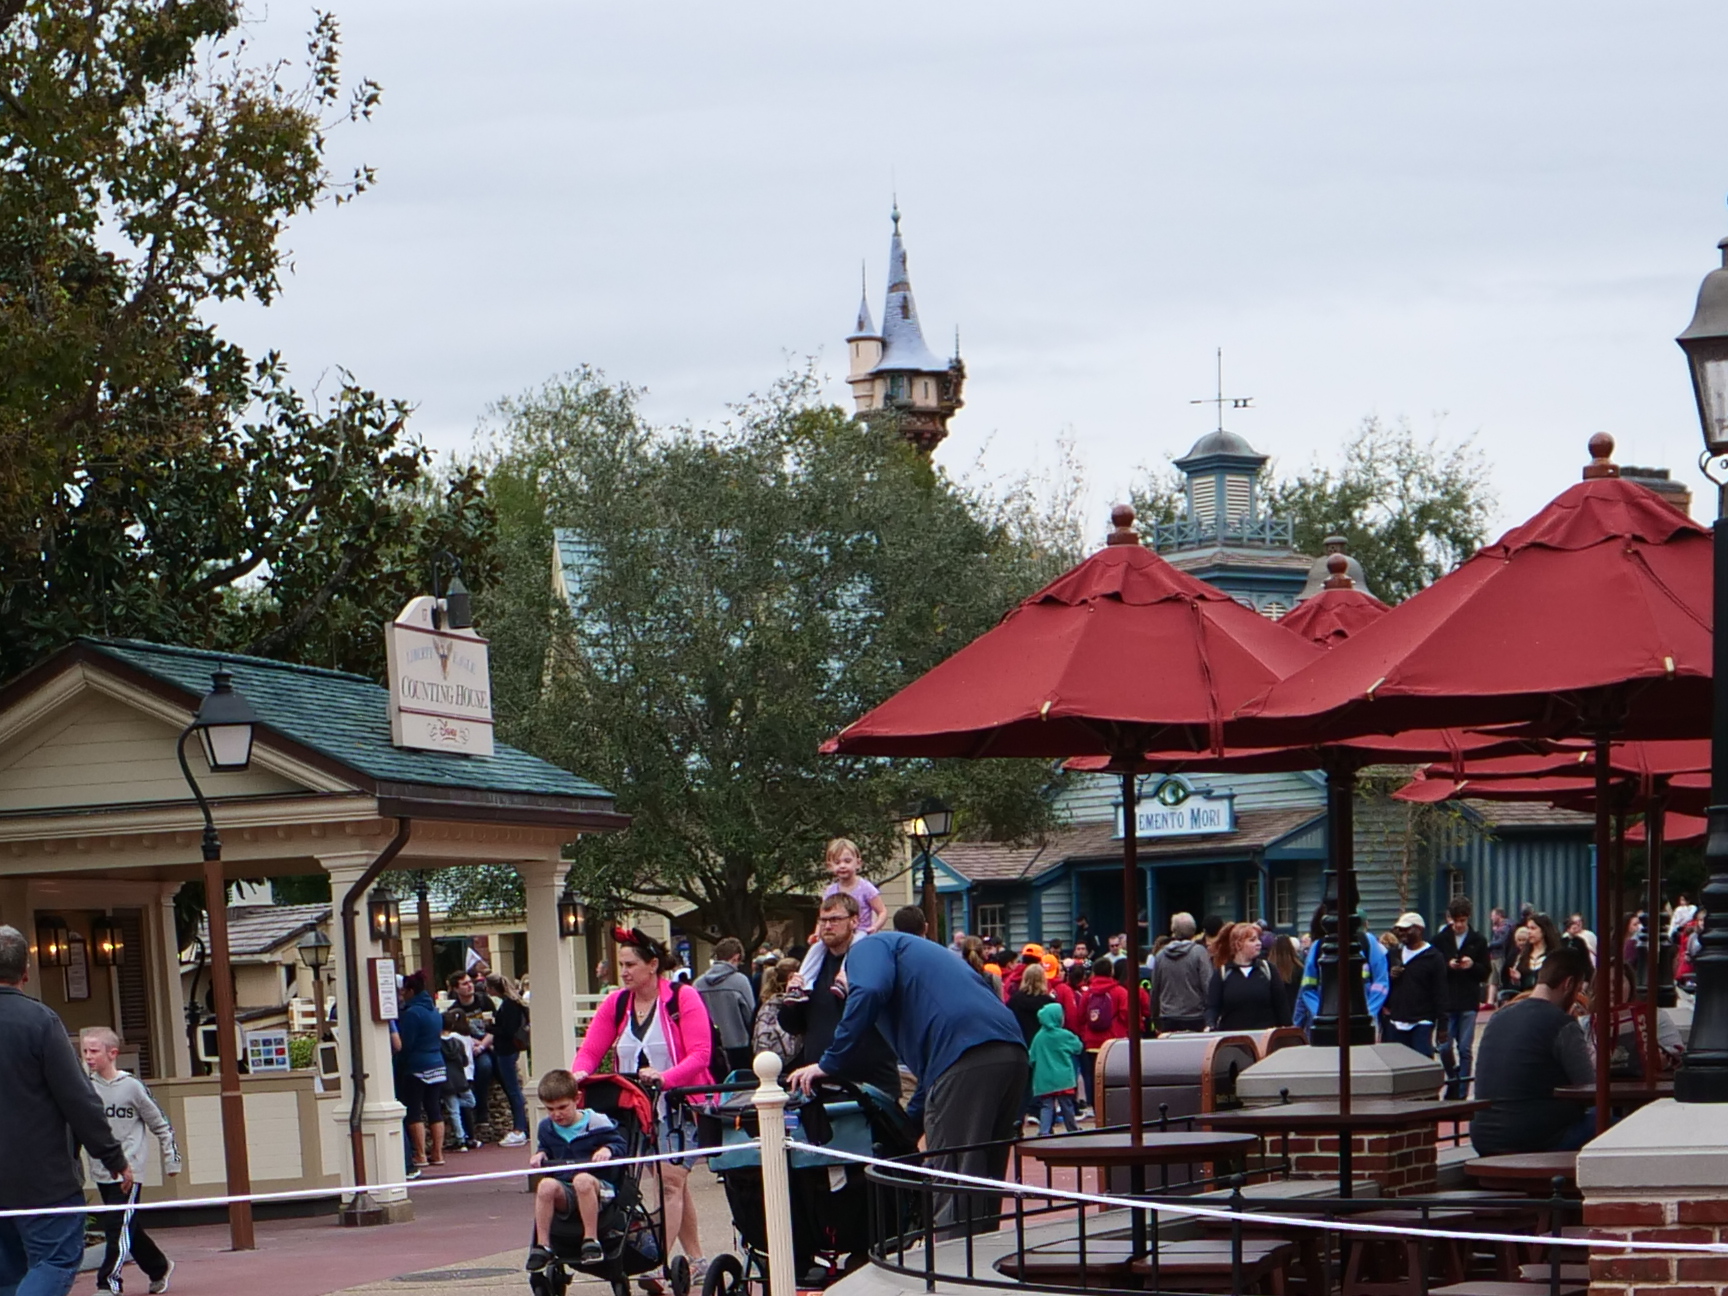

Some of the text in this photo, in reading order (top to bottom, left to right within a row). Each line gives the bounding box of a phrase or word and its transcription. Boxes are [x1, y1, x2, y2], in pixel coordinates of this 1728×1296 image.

[401, 675, 454, 704] COUNTING
[1139, 808, 1219, 830] EMENTO MORI
